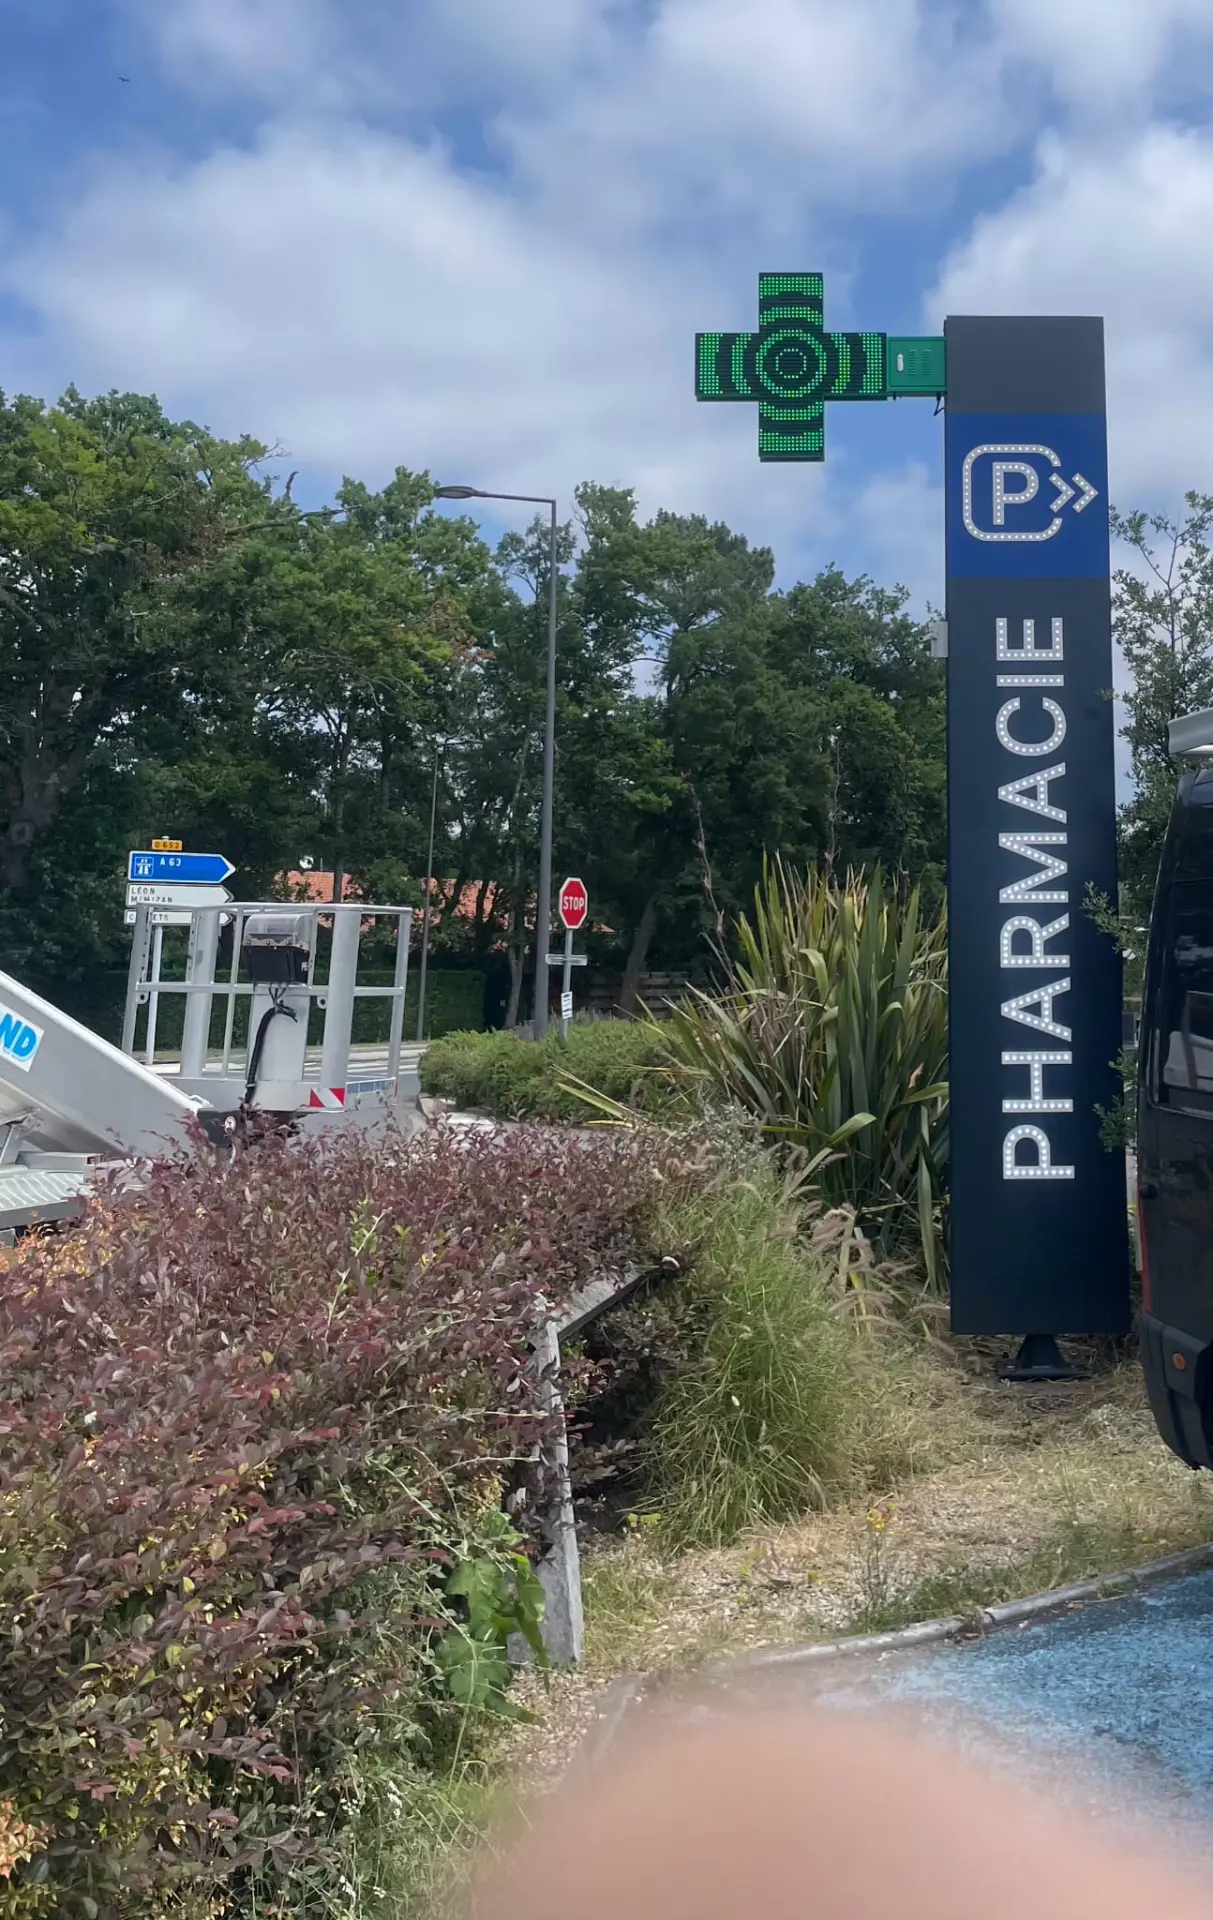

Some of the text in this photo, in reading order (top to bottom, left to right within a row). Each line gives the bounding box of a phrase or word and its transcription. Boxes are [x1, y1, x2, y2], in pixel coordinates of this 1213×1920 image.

[160, 856, 181, 867] A 63
[563, 896, 585, 910] STOP
[994, 616, 1076, 1181] PHARMACIE
